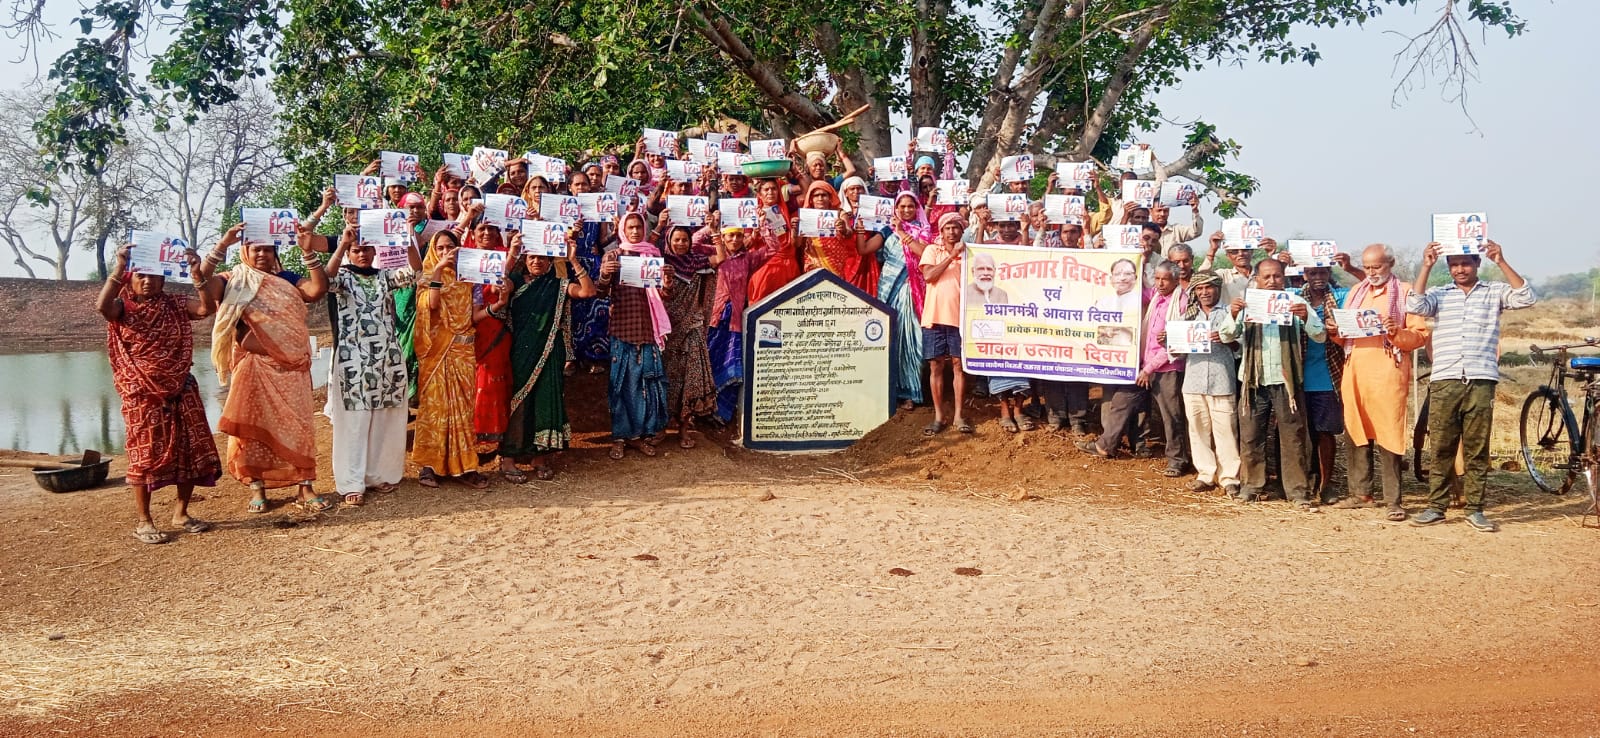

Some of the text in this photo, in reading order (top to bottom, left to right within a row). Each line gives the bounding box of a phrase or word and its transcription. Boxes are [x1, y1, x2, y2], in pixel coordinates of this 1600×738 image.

[723, 140, 736, 149] 125
[360, 186, 378, 198] 125
[508, 206, 525, 217] 125
[598, 200, 615, 212] 125
[271, 219, 294, 234] 125
[386, 220, 406, 233] 125
[1460, 223, 1482, 238] 125
[545, 232, 564, 244] 125
[482, 260, 502, 272] 125
[998, 256, 1108, 286] रोजगार दिवस
[1043, 286, 1062, 301] एवं
[984, 303, 1123, 323] प्रधानमंत्री आवास दिवस
[1270, 298, 1290, 313] 125
[1007, 324, 1031, 334] प्रत्येक
[1056, 327, 1080, 337] तारीख
[1084, 331, 1095, 339] का
[976, 342, 1018, 356] चावल
[1084, 343, 1128, 363] दिवस
